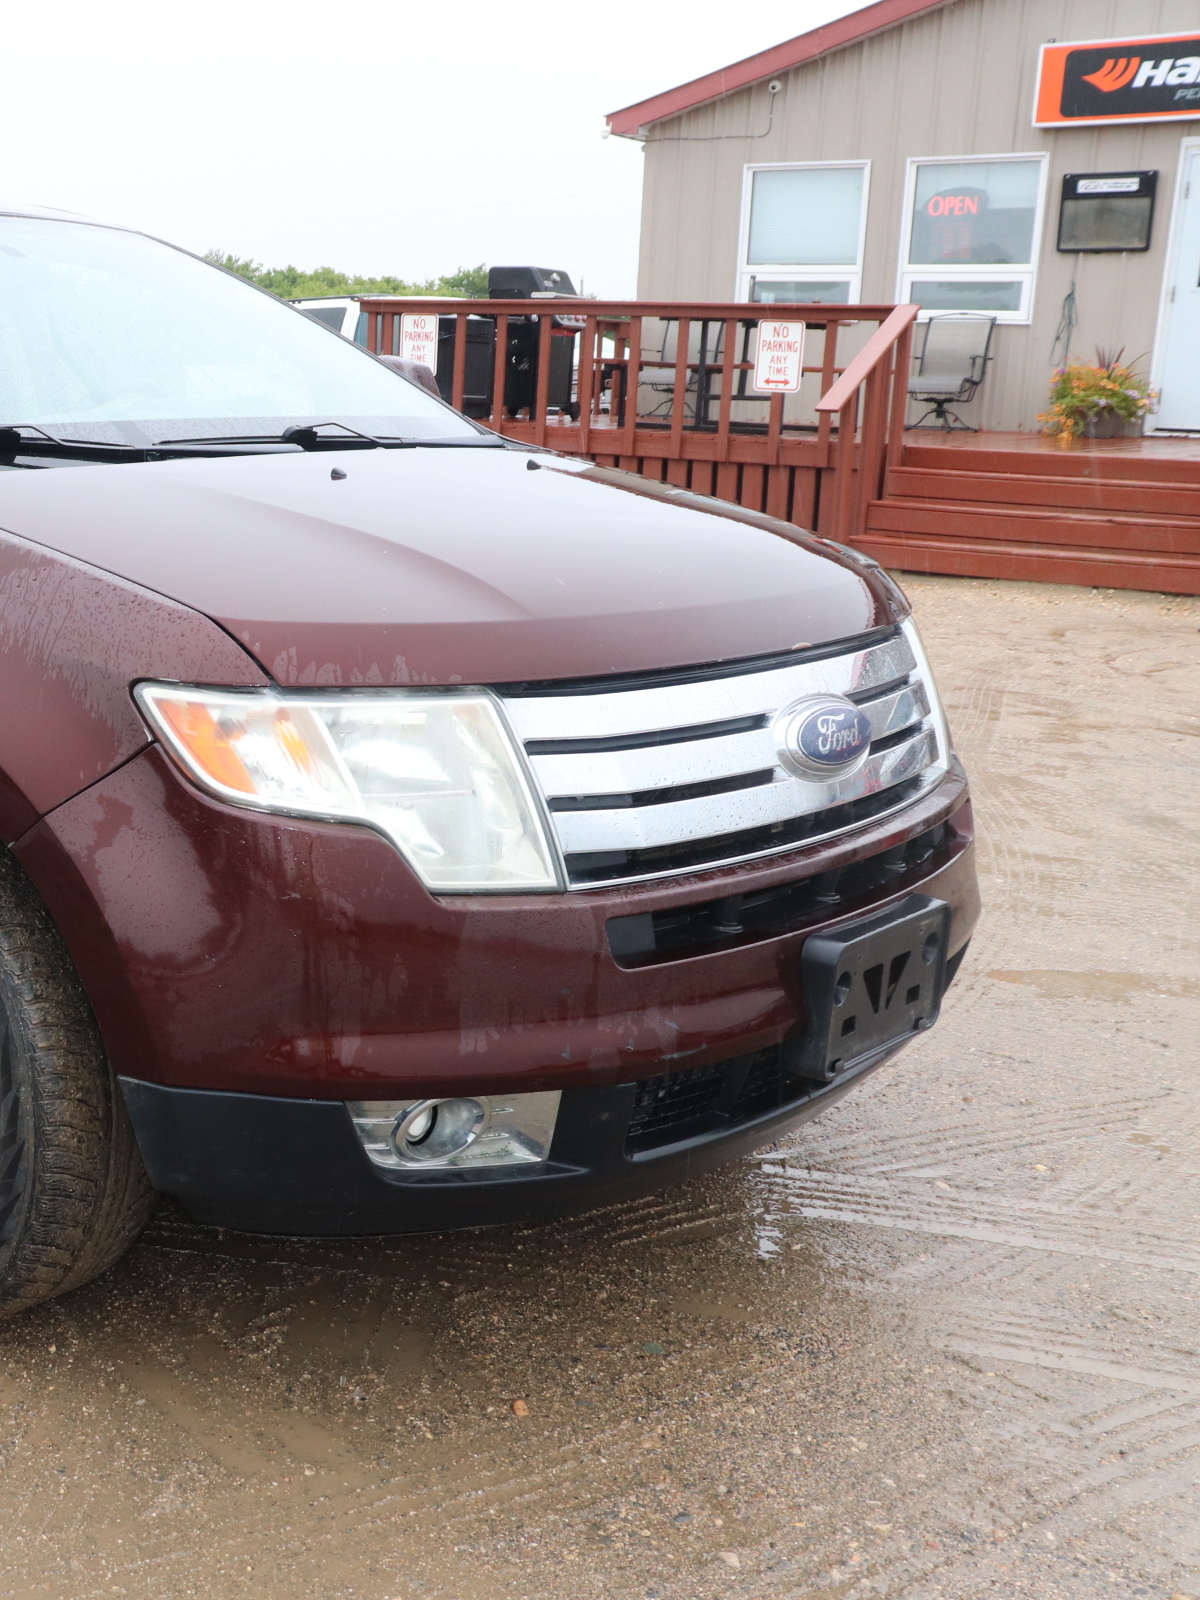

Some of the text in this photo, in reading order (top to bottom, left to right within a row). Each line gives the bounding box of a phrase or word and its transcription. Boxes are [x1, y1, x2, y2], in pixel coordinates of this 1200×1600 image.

[1131, 56, 1200, 88] Ha
[1173, 87, 1200, 100] PE
[928, 195, 978, 216] OPEN
[413, 318, 426, 329] NO
[404, 331, 434, 342] PARKING
[773, 326, 789, 338] NO
[412, 344, 426, 352] ANY
[761, 340, 798, 353] PARKING
[410, 354, 427, 362] TIME
[770, 355, 788, 365] ANY
[768, 366, 788, 376] TIME
[817, 713, 862, 755] Ford
